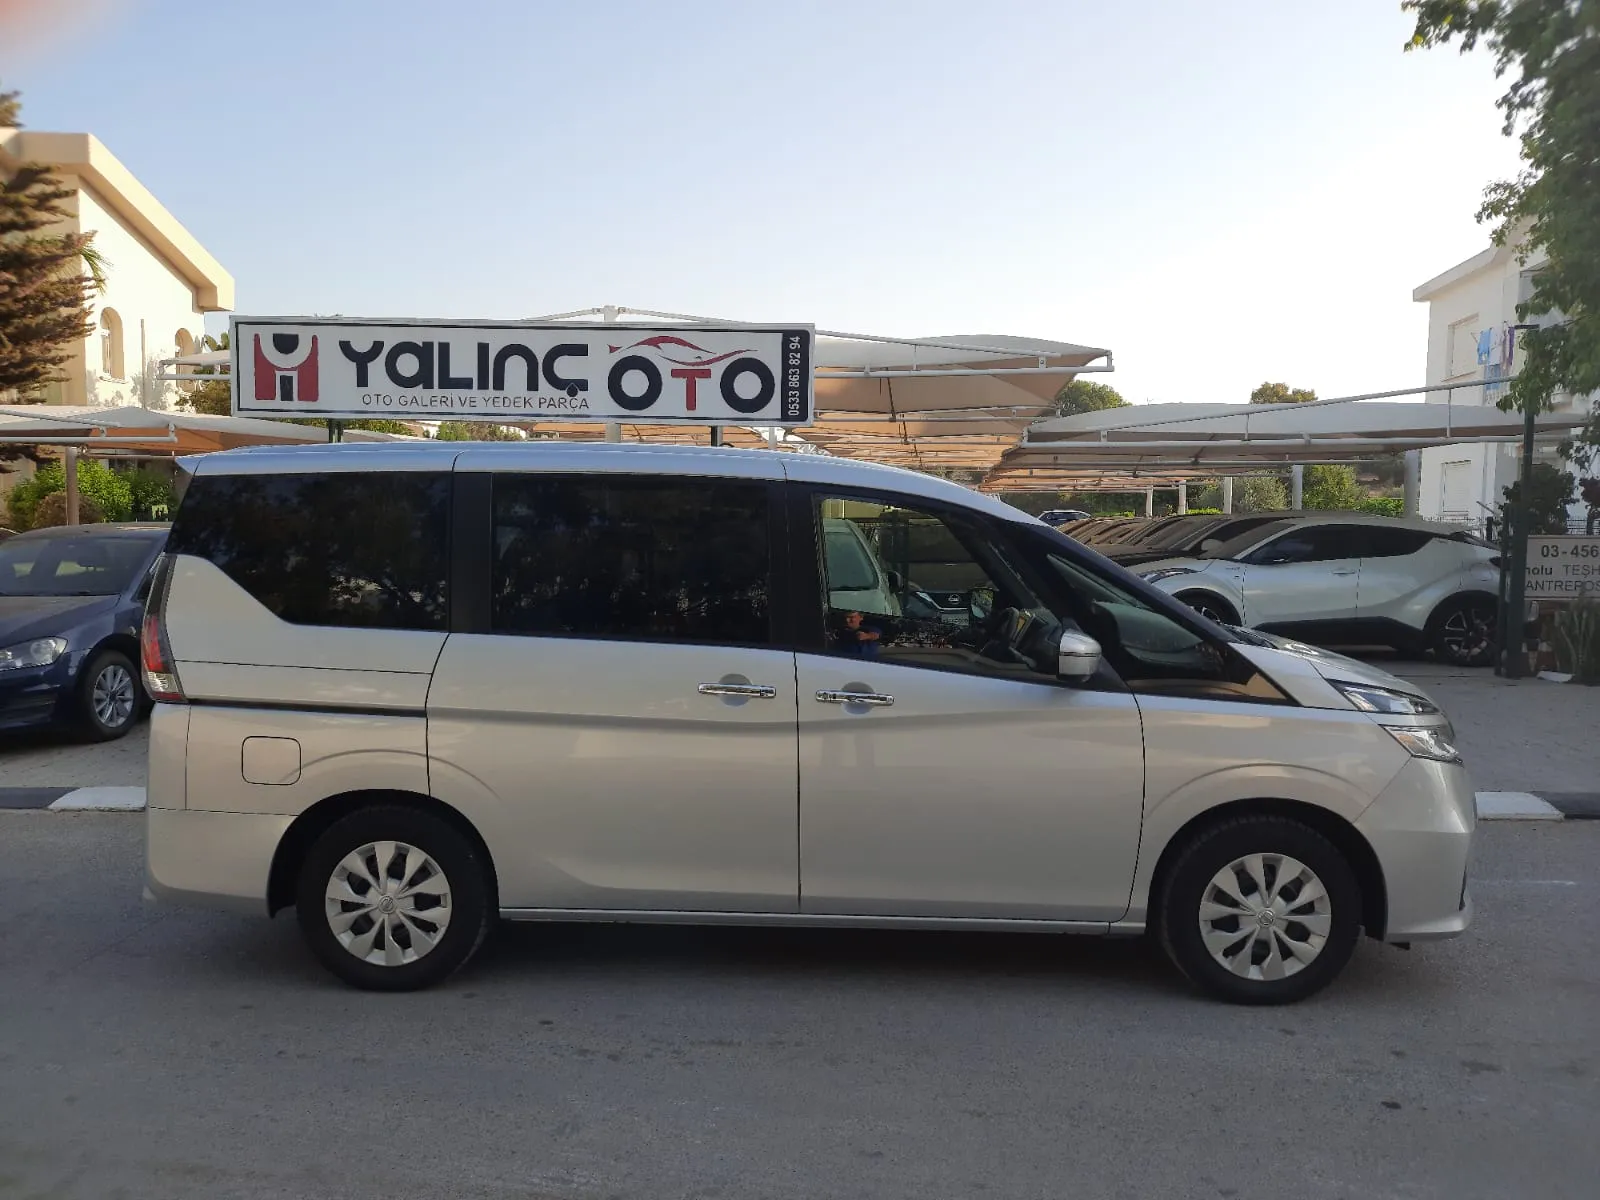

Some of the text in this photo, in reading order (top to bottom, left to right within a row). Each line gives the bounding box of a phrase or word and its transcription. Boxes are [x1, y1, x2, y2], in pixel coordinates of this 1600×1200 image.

[362, 393, 393, 406] OTO
[457, 395, 478, 408] VE
[482, 396, 534, 409] YEDEK
[538, 396, 590, 413] PARÇA
[607, 355, 776, 414] OTO
[788, 335, 801, 416] 0533 863 82 94
